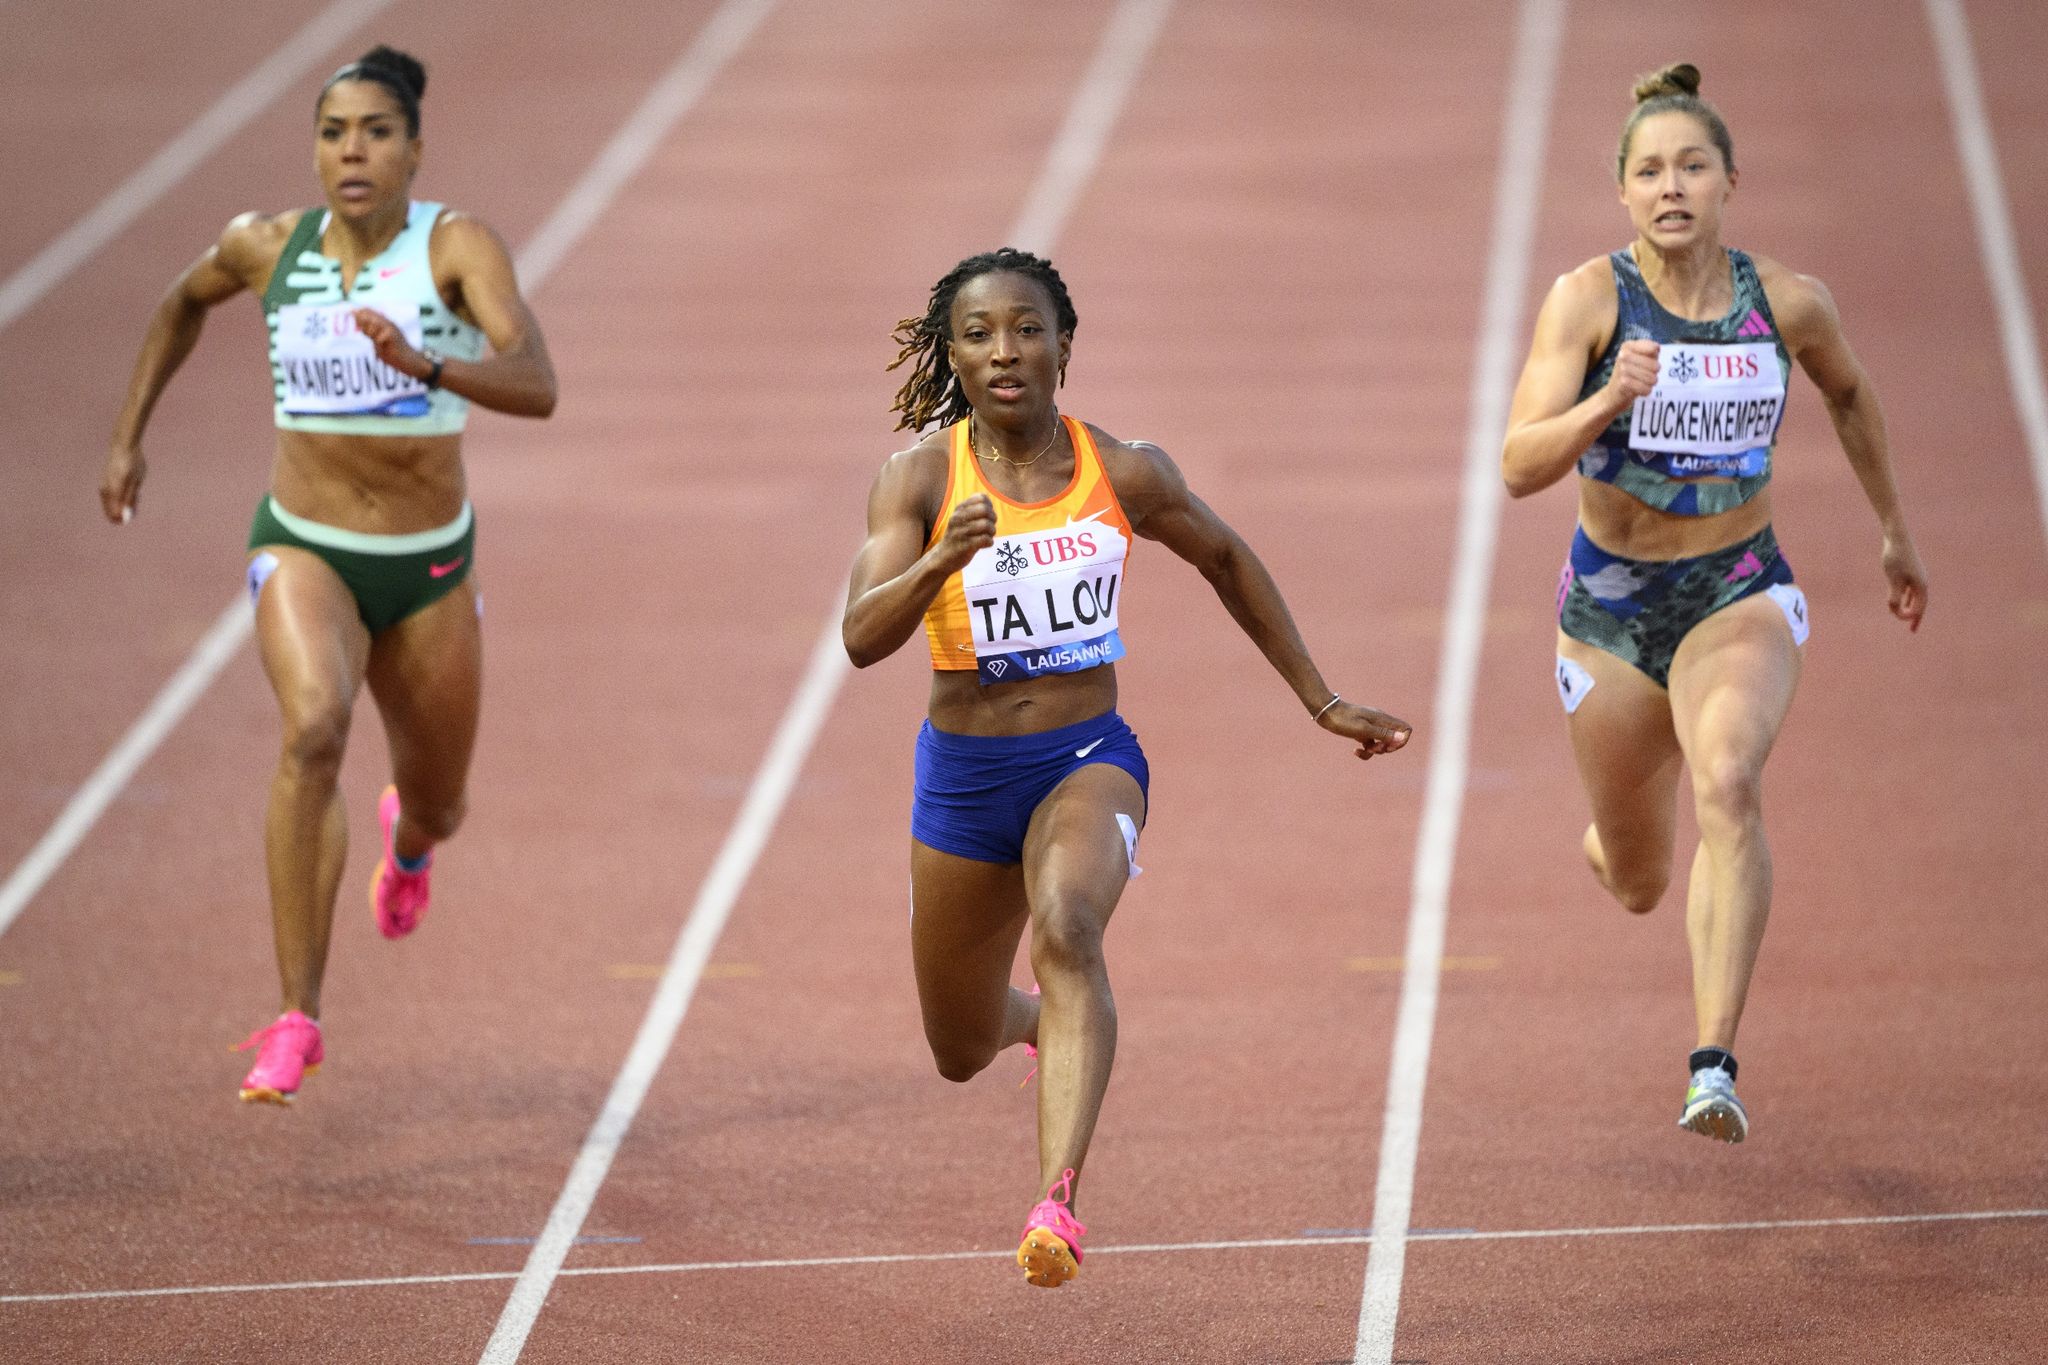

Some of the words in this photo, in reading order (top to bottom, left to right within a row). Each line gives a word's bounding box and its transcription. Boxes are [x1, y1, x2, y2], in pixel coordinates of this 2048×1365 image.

[285, 356, 422, 396] KAMBUND
[1703, 353, 1759, 379] UBS
[1638, 391, 1776, 442] LÜCKENKEMPER
[1671, 454, 1750, 472] LAUSANNE
[1029, 532, 1098, 566] UBS
[972, 594, 1034, 642] TA
[1044, 574, 1117, 633] LOU
[1026, 640, 1112, 671] LAUSANNE
